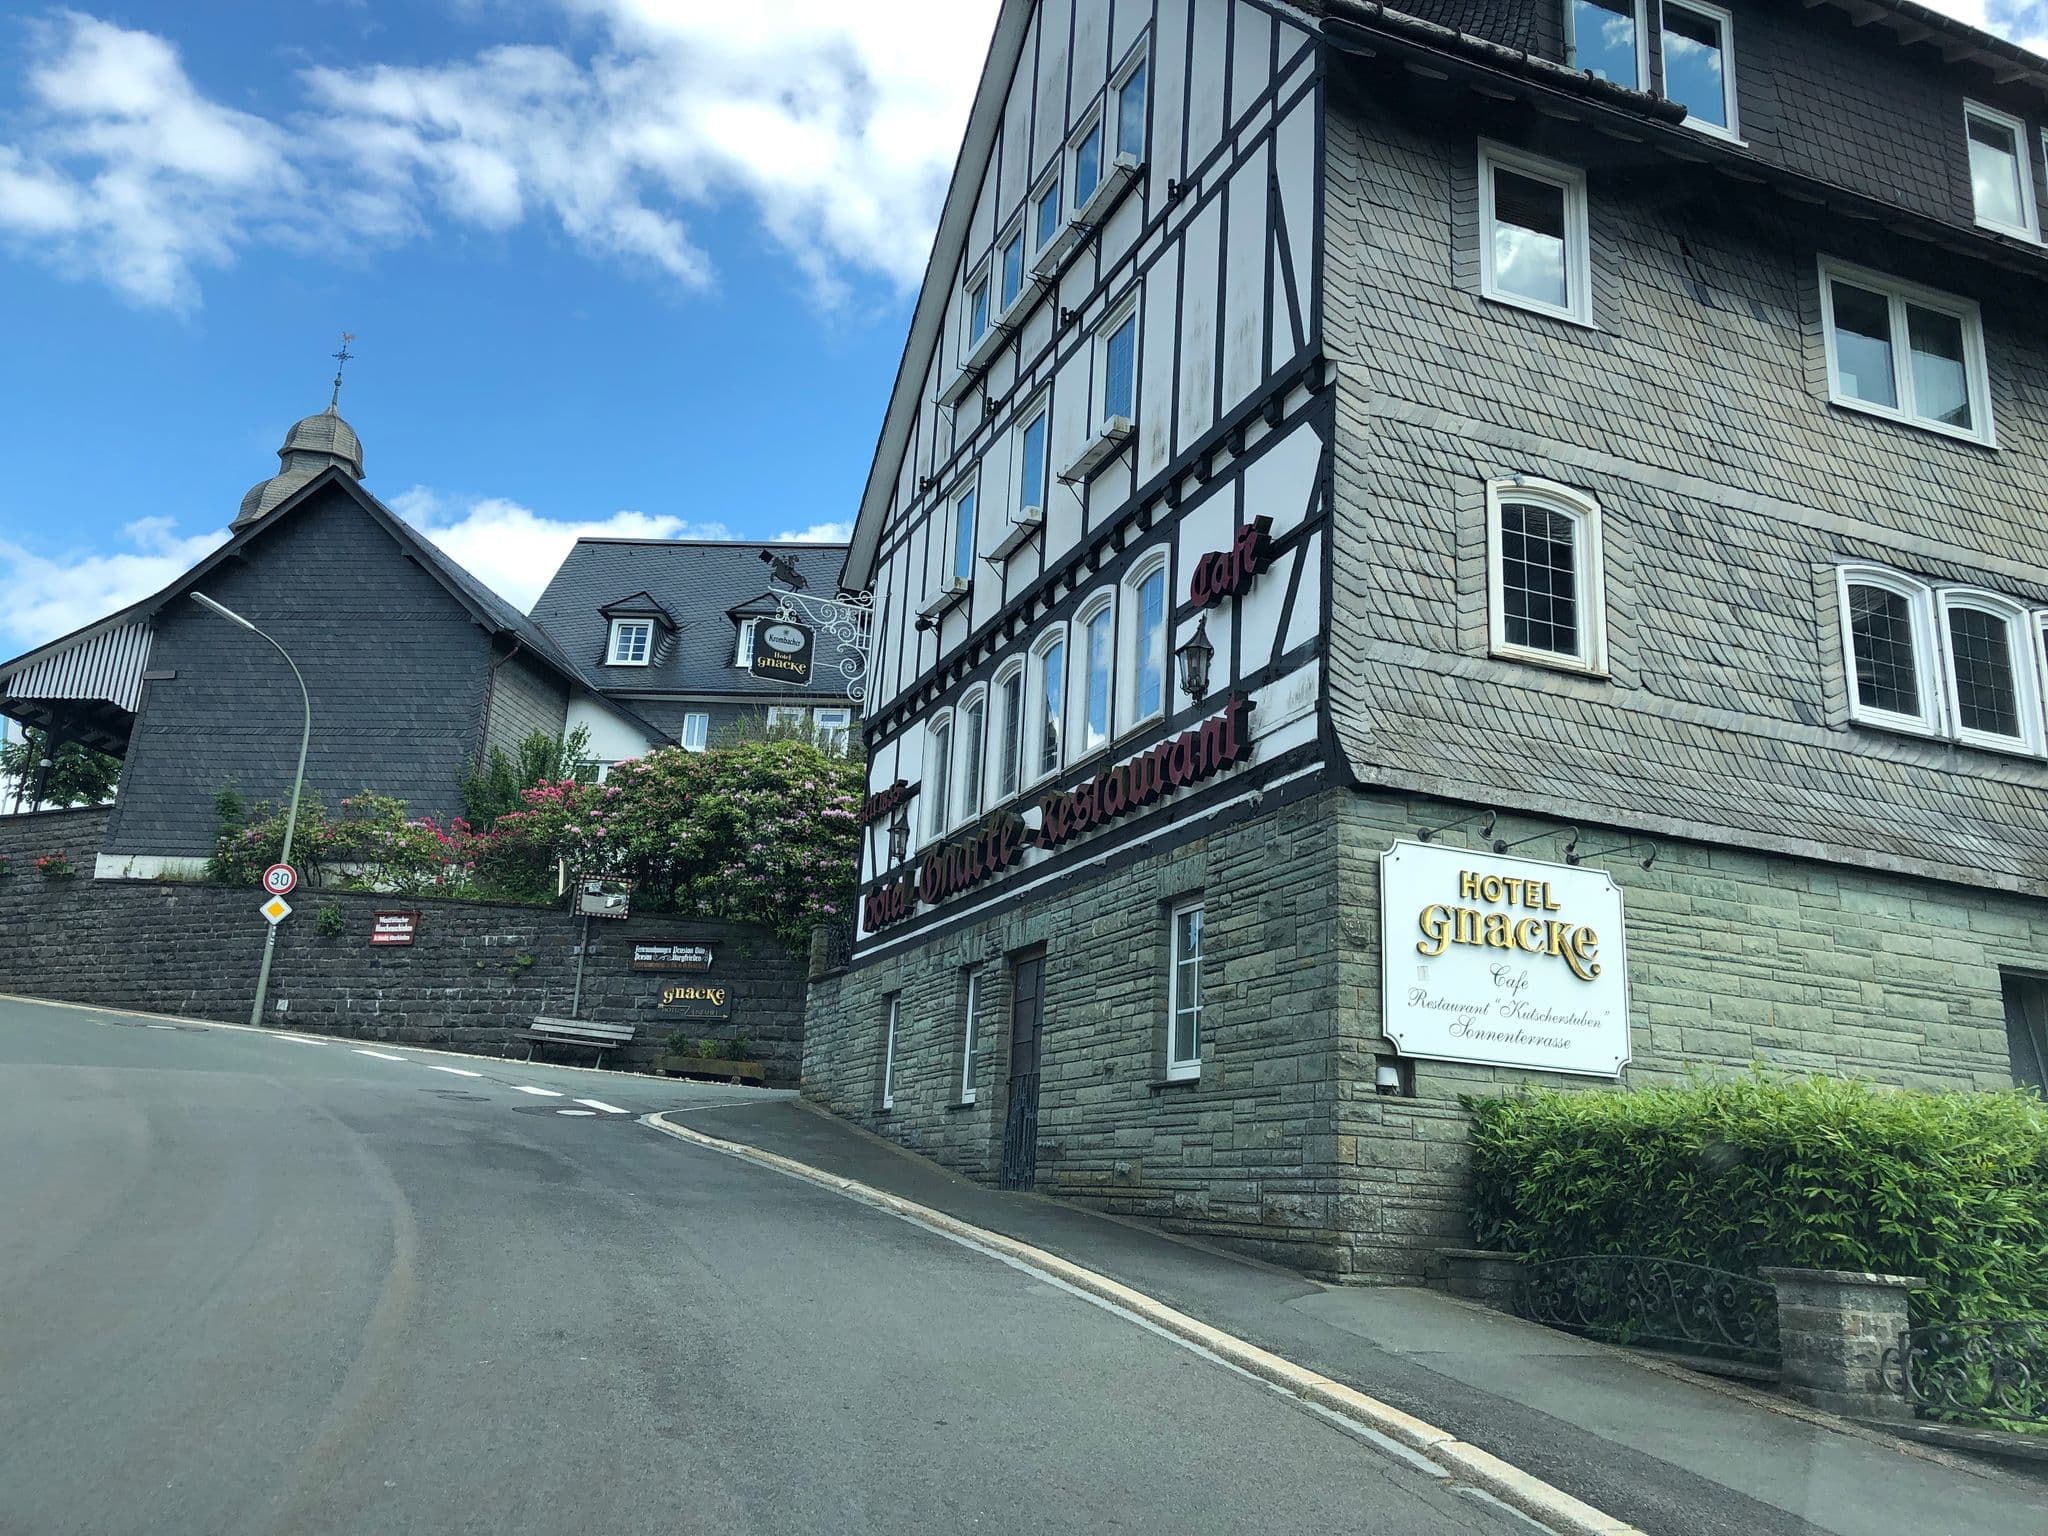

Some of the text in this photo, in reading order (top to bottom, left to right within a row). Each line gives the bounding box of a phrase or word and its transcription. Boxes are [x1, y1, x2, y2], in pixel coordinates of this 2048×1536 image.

[774, 651, 792, 660] Hotel
[271, 872, 290, 886] 30
[1460, 870, 1561, 911] HOTEL
[1490, 963, 1529, 997] Cafe
[1408, 987, 1490, 1015] Restaurant
[1448, 1015, 1572, 1049] Sonnenterrasse
